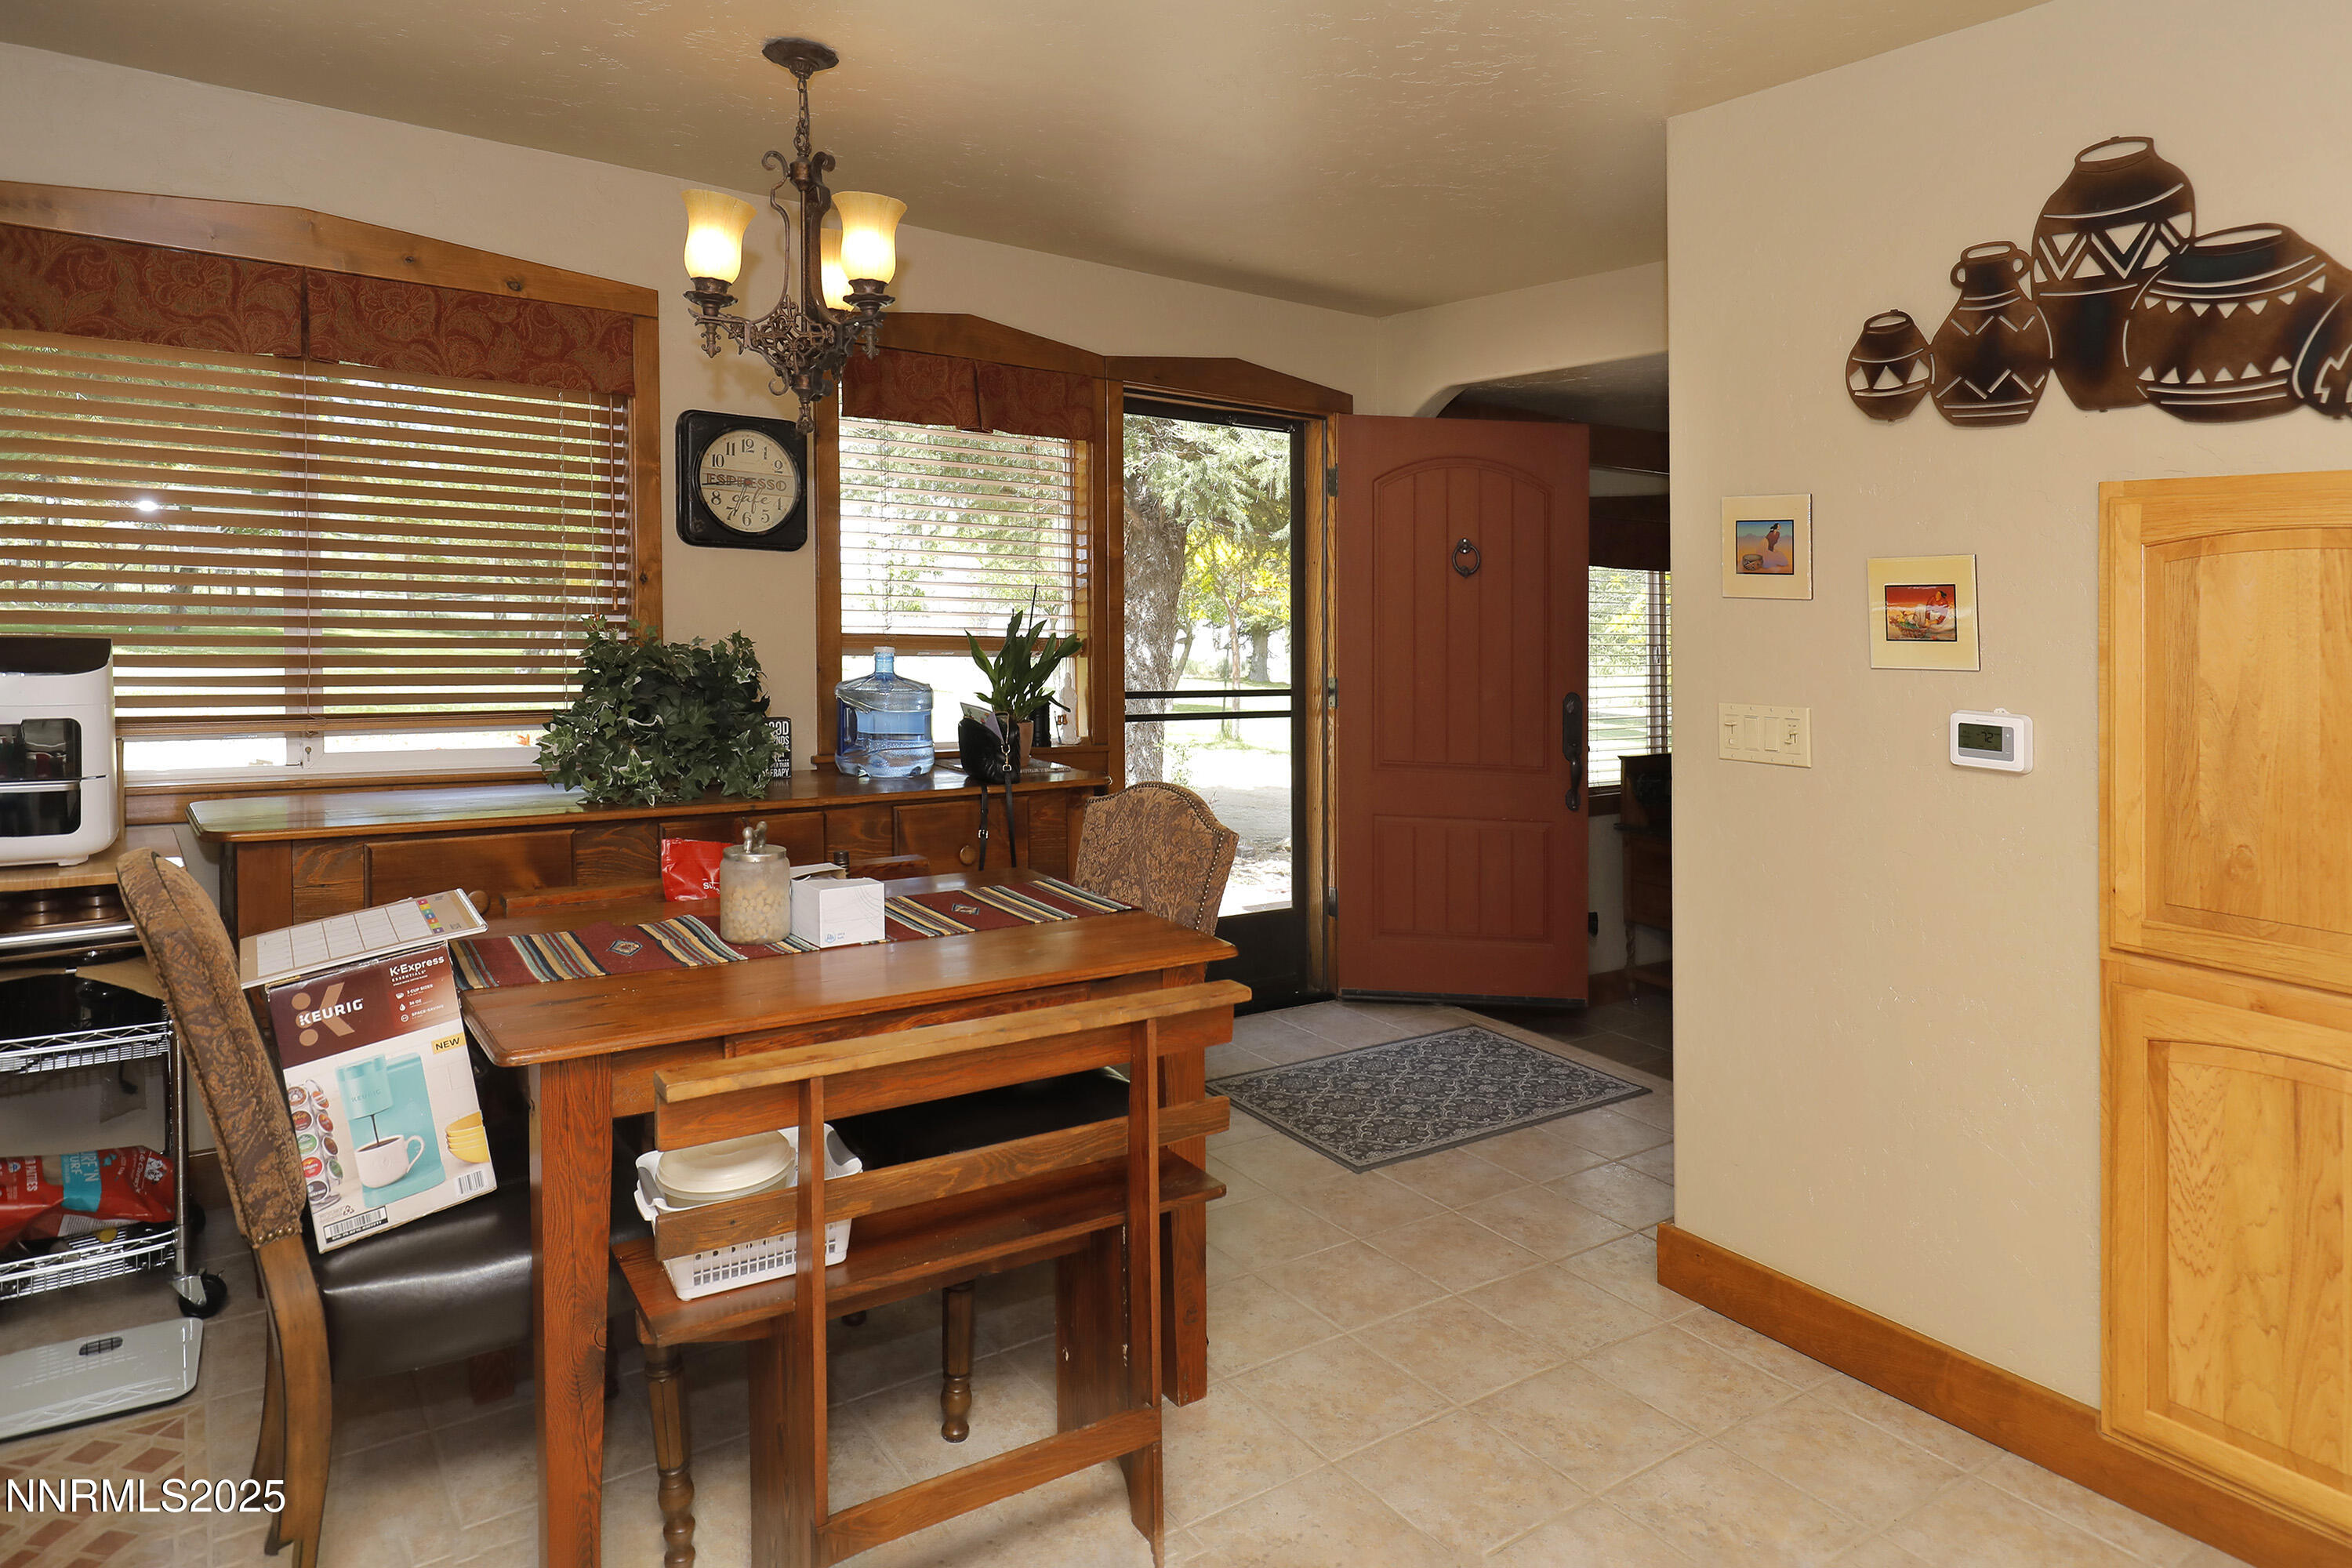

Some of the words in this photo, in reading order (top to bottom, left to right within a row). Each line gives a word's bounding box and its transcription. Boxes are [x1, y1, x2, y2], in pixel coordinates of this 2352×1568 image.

[726, 441, 735, 456] 11
[741, 438, 754, 453] 12
[763, 445, 768, 460] 1
[711, 453, 724, 467] 10
[774, 459, 783, 474] 2
[706, 473, 787, 492] ESPRESSO
[711, 490, 721, 506] 8
[726, 506, 736, 521] 7
[742, 511, 751, 527] 6
[760, 510, 770, 523] 5
[1981, 731, 1994, 743] 72
[299, 998, 363, 1026] KEURIG
[435, 1037, 460, 1051] NEW
[69, 1156, 82, 1174] URF
